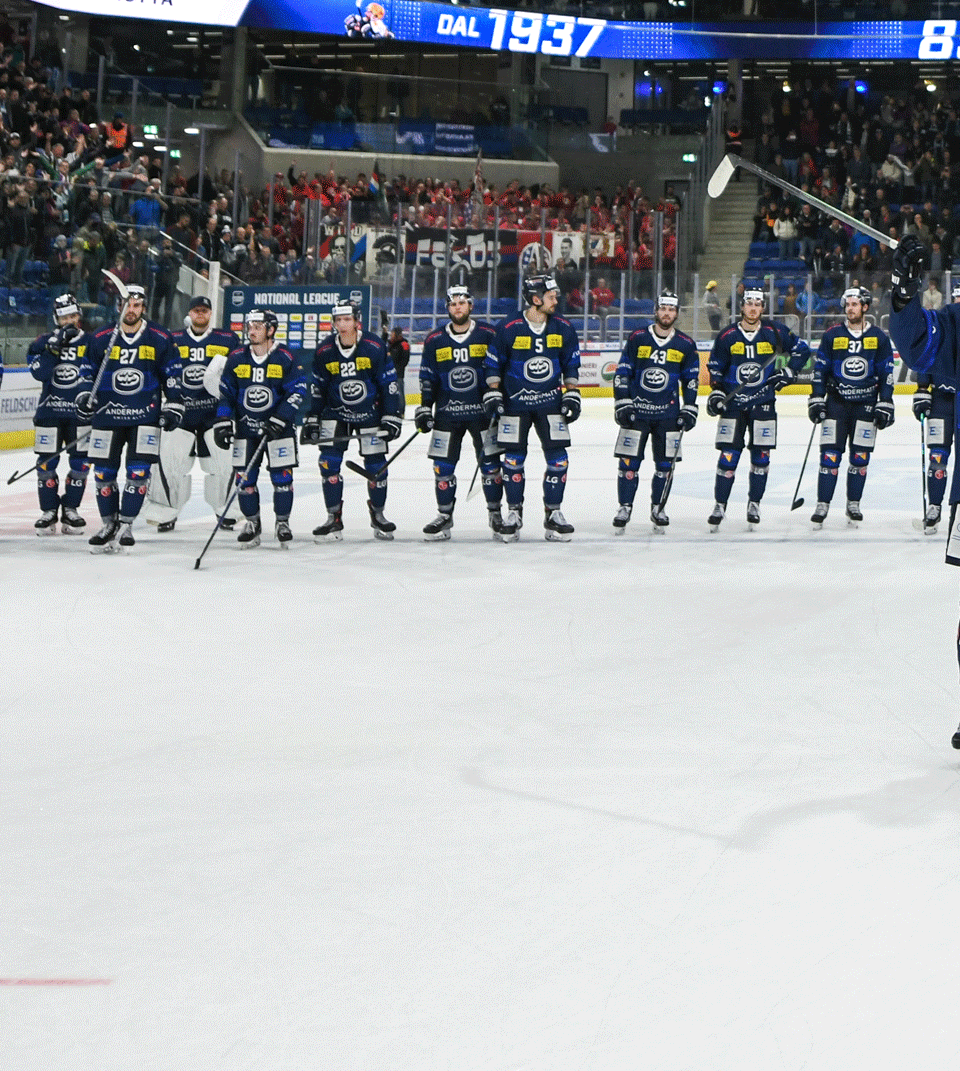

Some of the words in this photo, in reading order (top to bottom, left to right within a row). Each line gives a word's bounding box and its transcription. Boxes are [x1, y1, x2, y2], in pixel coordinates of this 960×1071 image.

[436, 13, 480, 38] DAL
[488, 8, 607, 57] 1937
[254, 293, 301, 305] NATIONAL
[303, 293, 341, 305] LEAGUE
[535, 338, 543, 353] 5
[745, 344, 755, 359] 11
[848, 341, 862, 354] 37
[60, 347, 76, 361] 55
[119, 348, 137, 364] 27
[188, 347, 204, 361] 30
[453, 348, 469, 363] 90
[650, 349, 667, 365] 43
[252, 366, 264, 383] 18
[340, 361, 356, 377] 22
